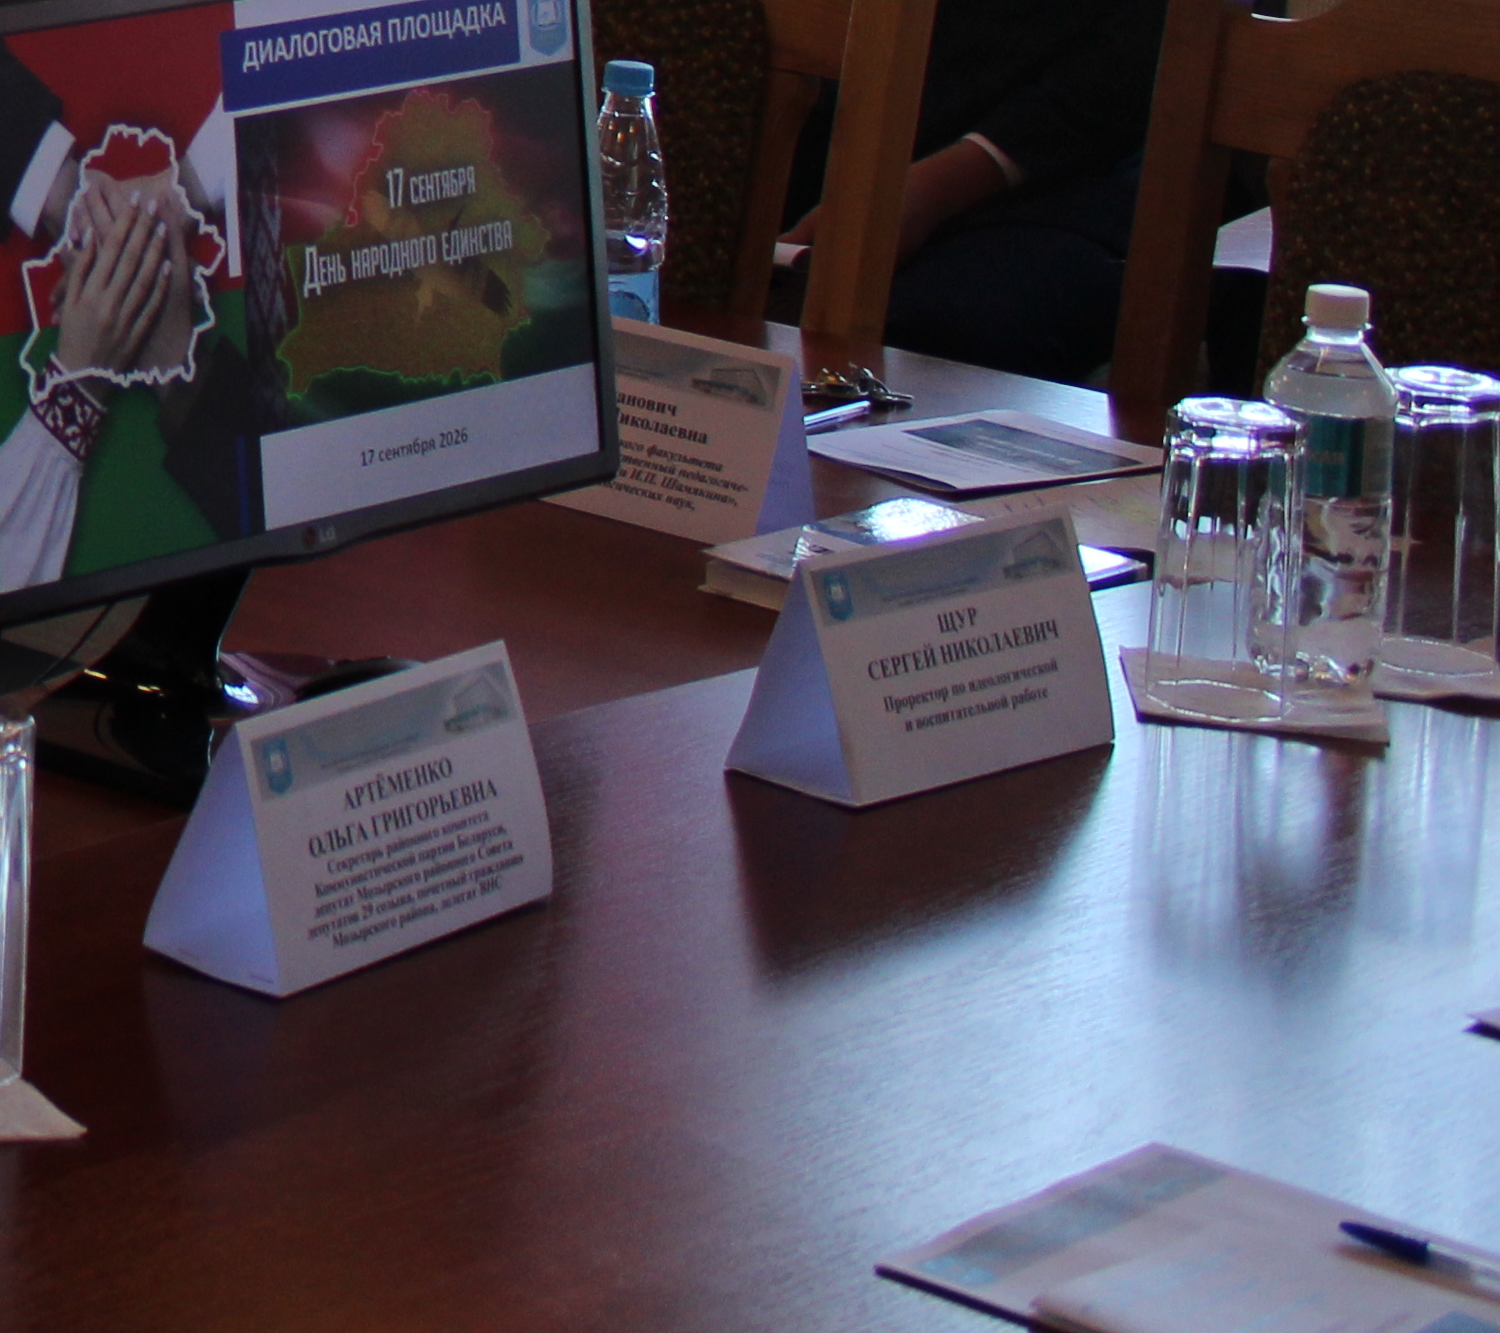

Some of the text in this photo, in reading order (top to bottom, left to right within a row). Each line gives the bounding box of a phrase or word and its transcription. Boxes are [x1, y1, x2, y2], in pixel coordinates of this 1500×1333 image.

[242, 1, 507, 74] ДИАЛОГОВАЯ ПЛОЩАДКА
[385, 167, 405, 208] 17
[616, 393, 677, 416] анович
[619, 413, 708, 444] иколаевна
[360, 449, 376, 467] 17
[378, 436, 436, 462] сентября
[937, 607, 977, 633] ЩУР
[867, 620, 1058, 680] СЕРГЕЙ НИКОЛАЕВИЧ
[883, 687, 949, 714] Проректор
[951, 683, 966, 696] по
[905, 688, 1048, 732] и воспитательной работе
[345, 759, 453, 809] АРТЁМЕНКО
[308, 780, 497, 858] ОЛЬГА ГРИГОРЬЕВНА
[327, 849, 384, 874] Секретарь
